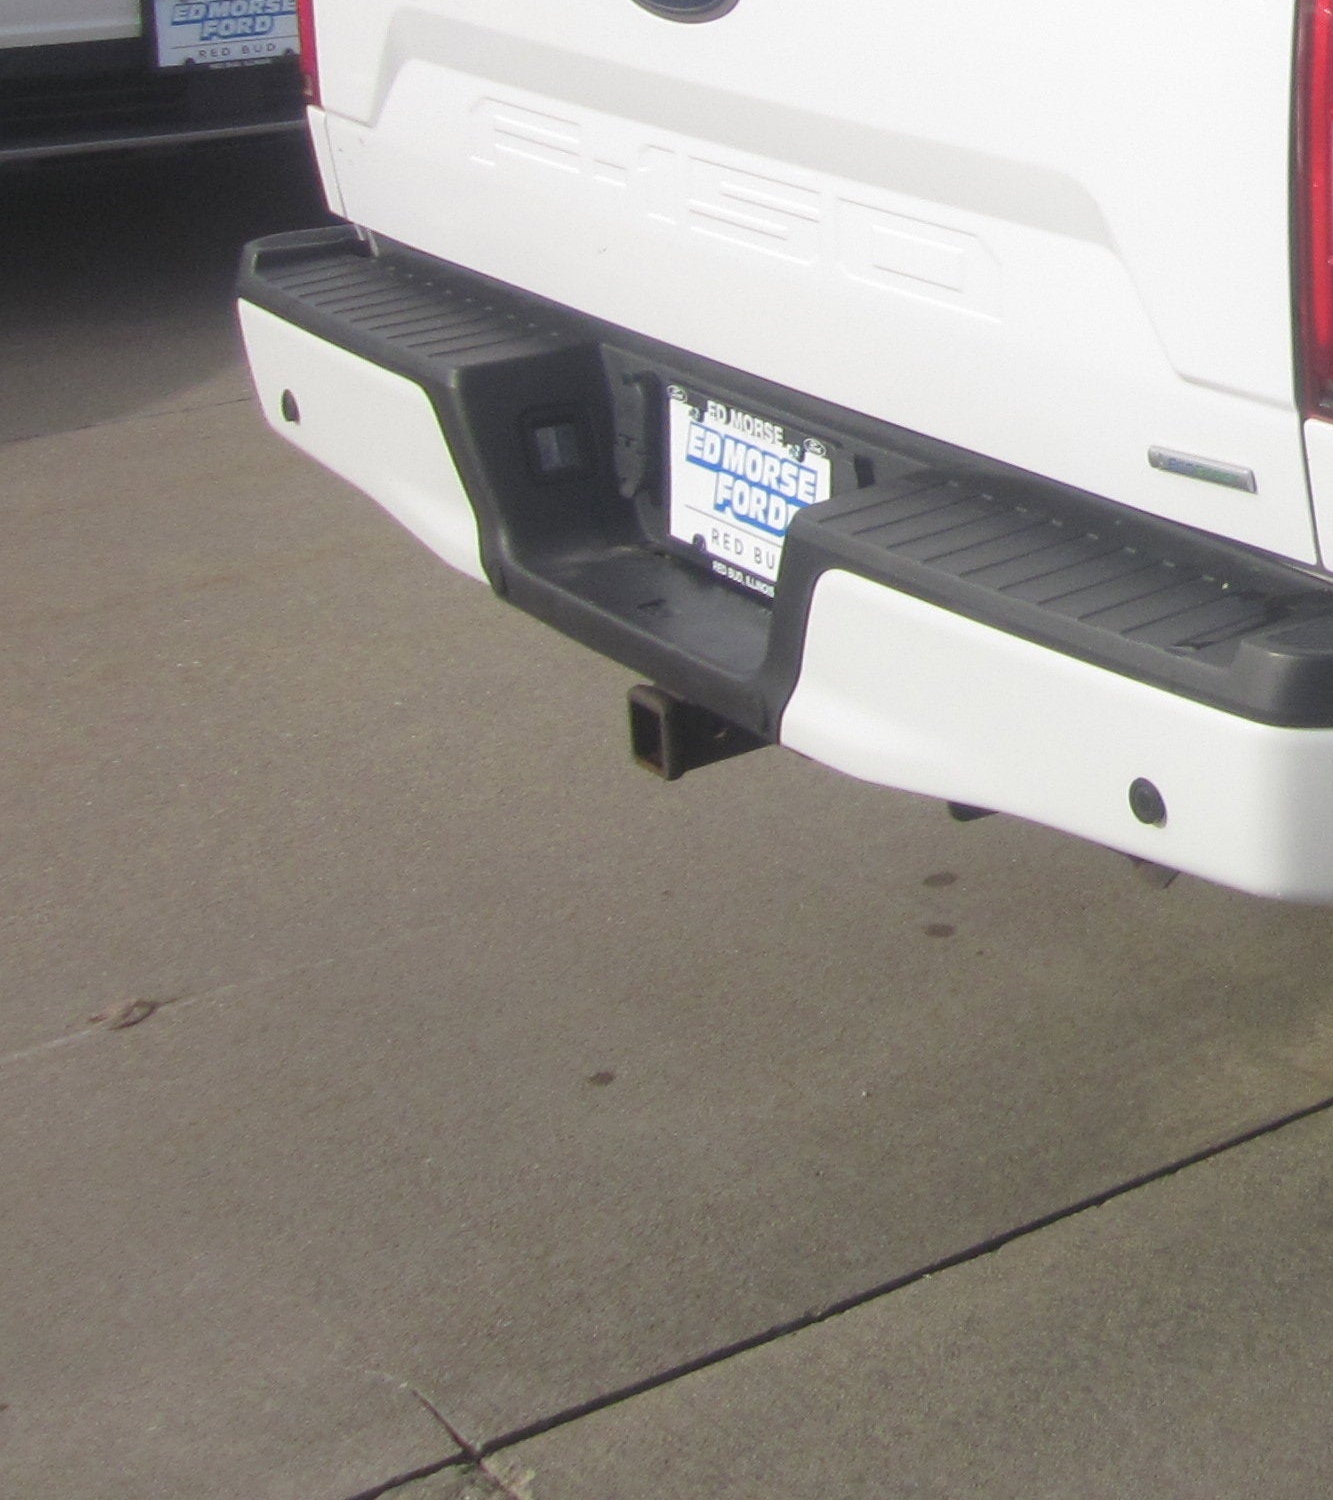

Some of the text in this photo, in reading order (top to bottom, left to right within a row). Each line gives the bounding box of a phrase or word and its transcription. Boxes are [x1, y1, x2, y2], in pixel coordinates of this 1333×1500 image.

[173, 2, 207, 23] ED
[201, 16, 273, 41] FORD
[199, 47, 231, 58] RED
[706, 400, 785, 446] ED MORSE
[687, 423, 817, 506] ED MORSE
[715, 473, 786, 535] FORD
[711, 528, 776, 570] RED BU
